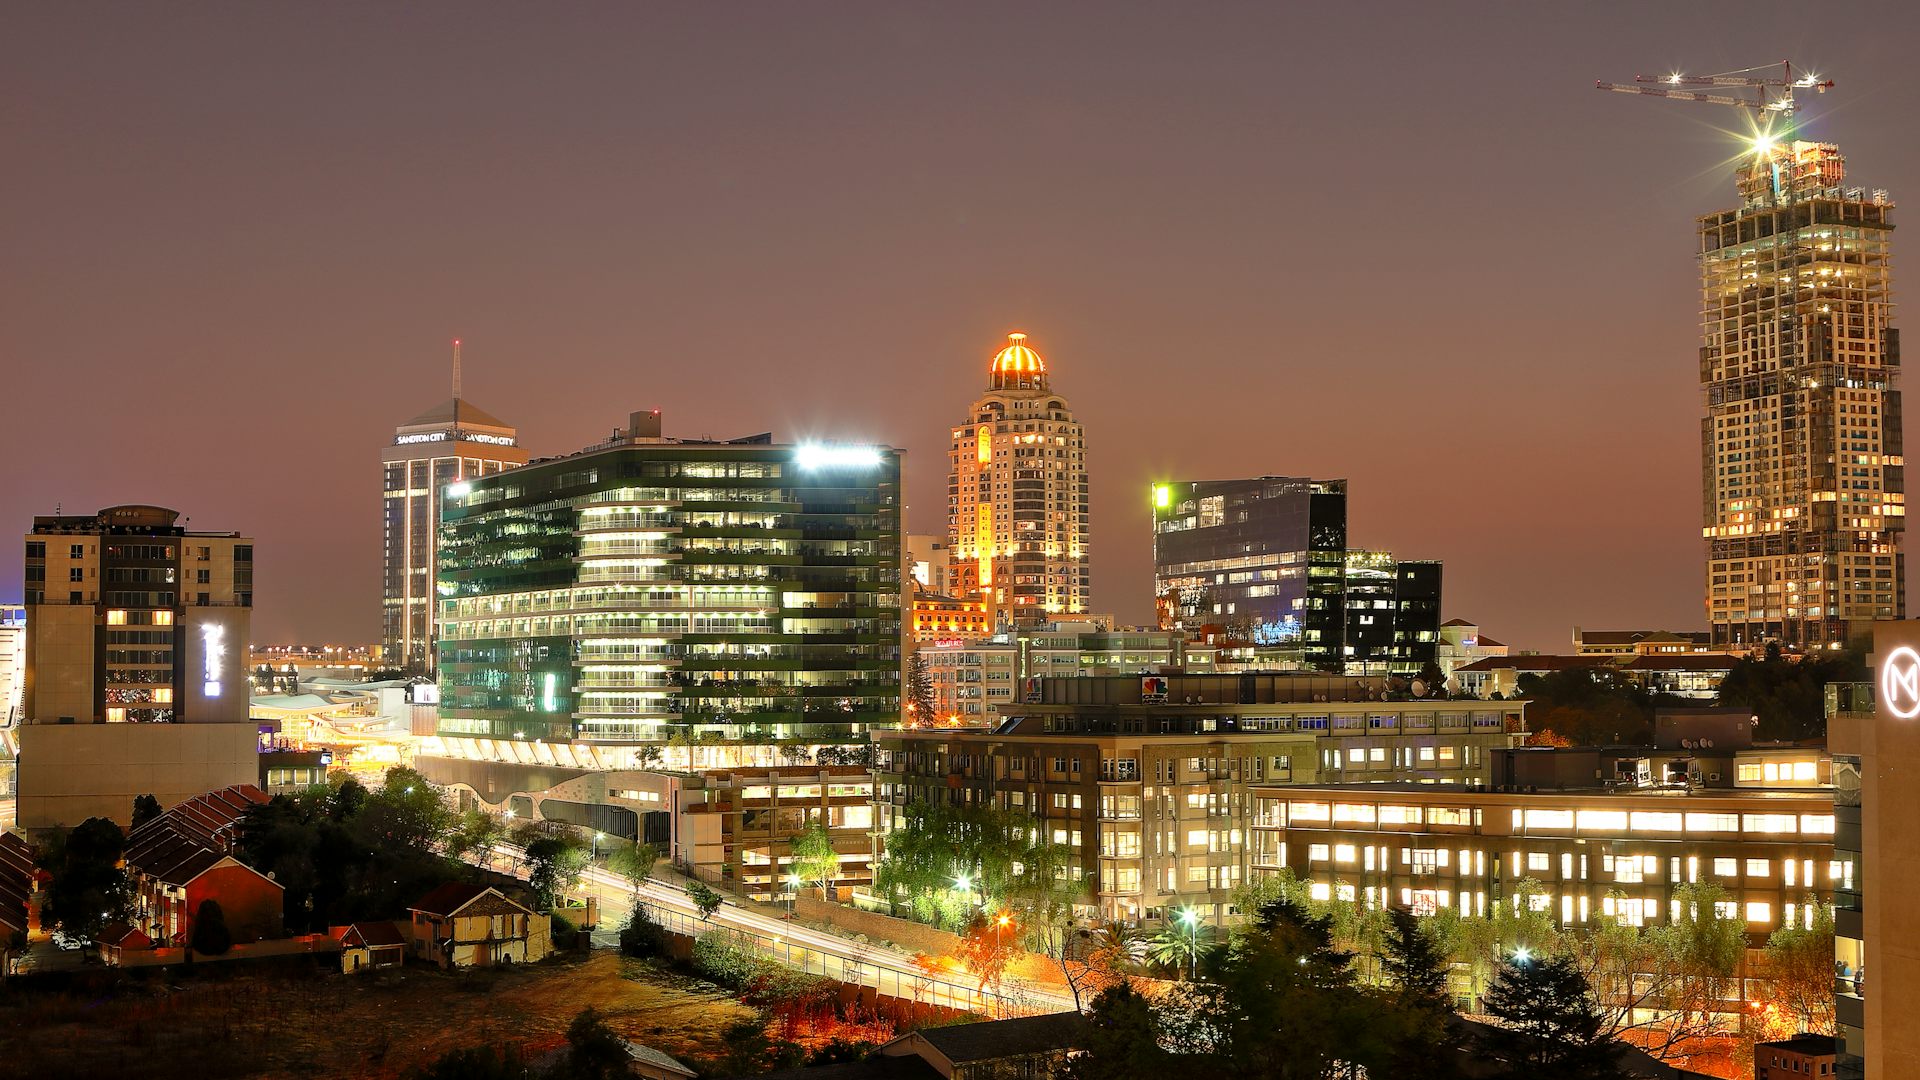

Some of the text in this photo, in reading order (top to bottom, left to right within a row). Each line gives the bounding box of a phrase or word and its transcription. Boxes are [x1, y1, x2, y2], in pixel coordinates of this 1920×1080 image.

[397, 432, 446, 444] SANDTON CITY
[498, 437, 514, 446] CITY
